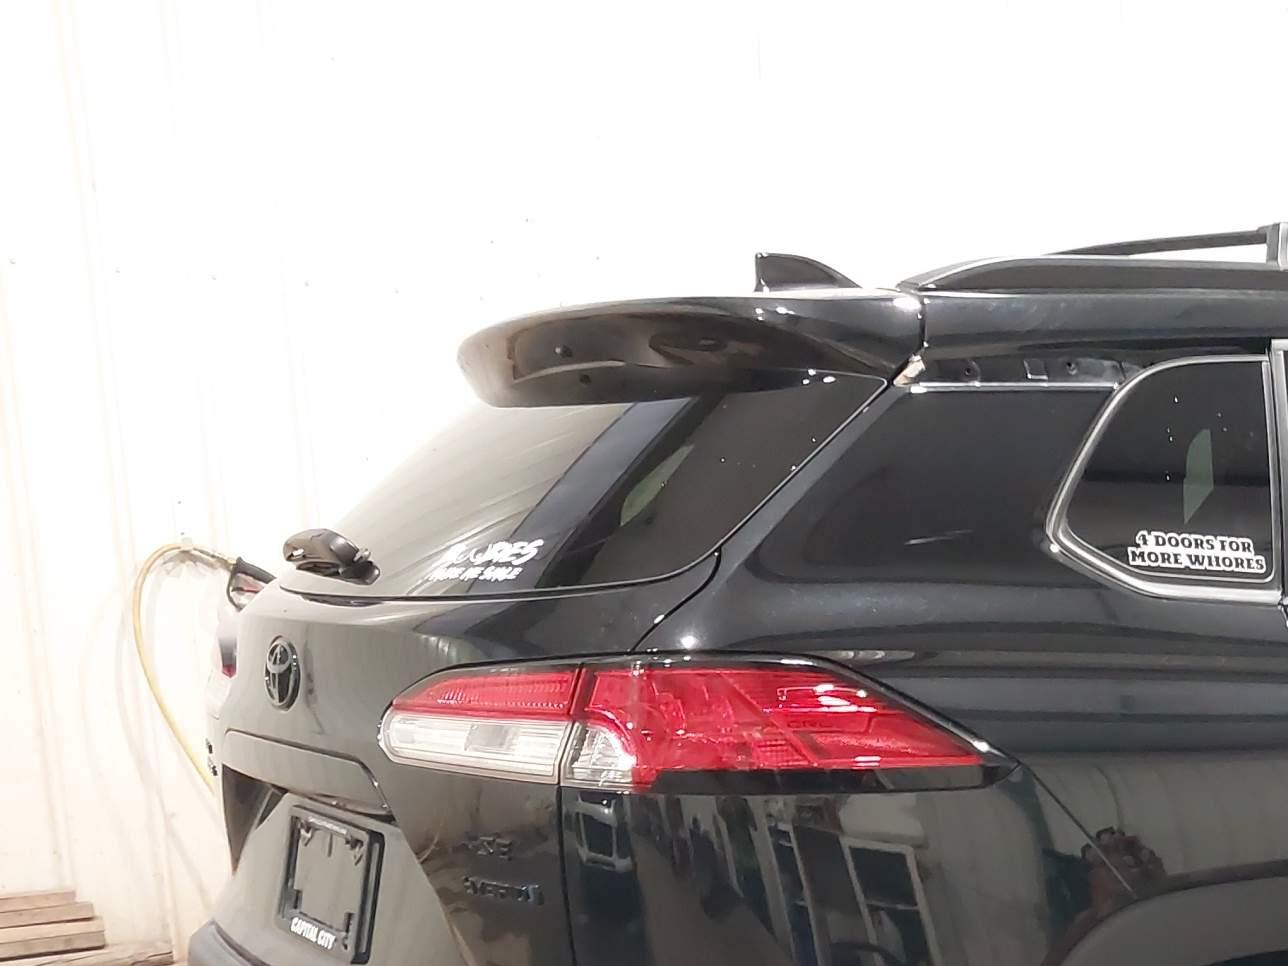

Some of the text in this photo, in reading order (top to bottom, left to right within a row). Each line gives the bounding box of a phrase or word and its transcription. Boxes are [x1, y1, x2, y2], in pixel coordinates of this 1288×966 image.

[1155, 534, 1215, 550] DOORS
[1131, 550, 1183, 565] MORE
[290, 916, 337, 950] CAPITAL CITY
